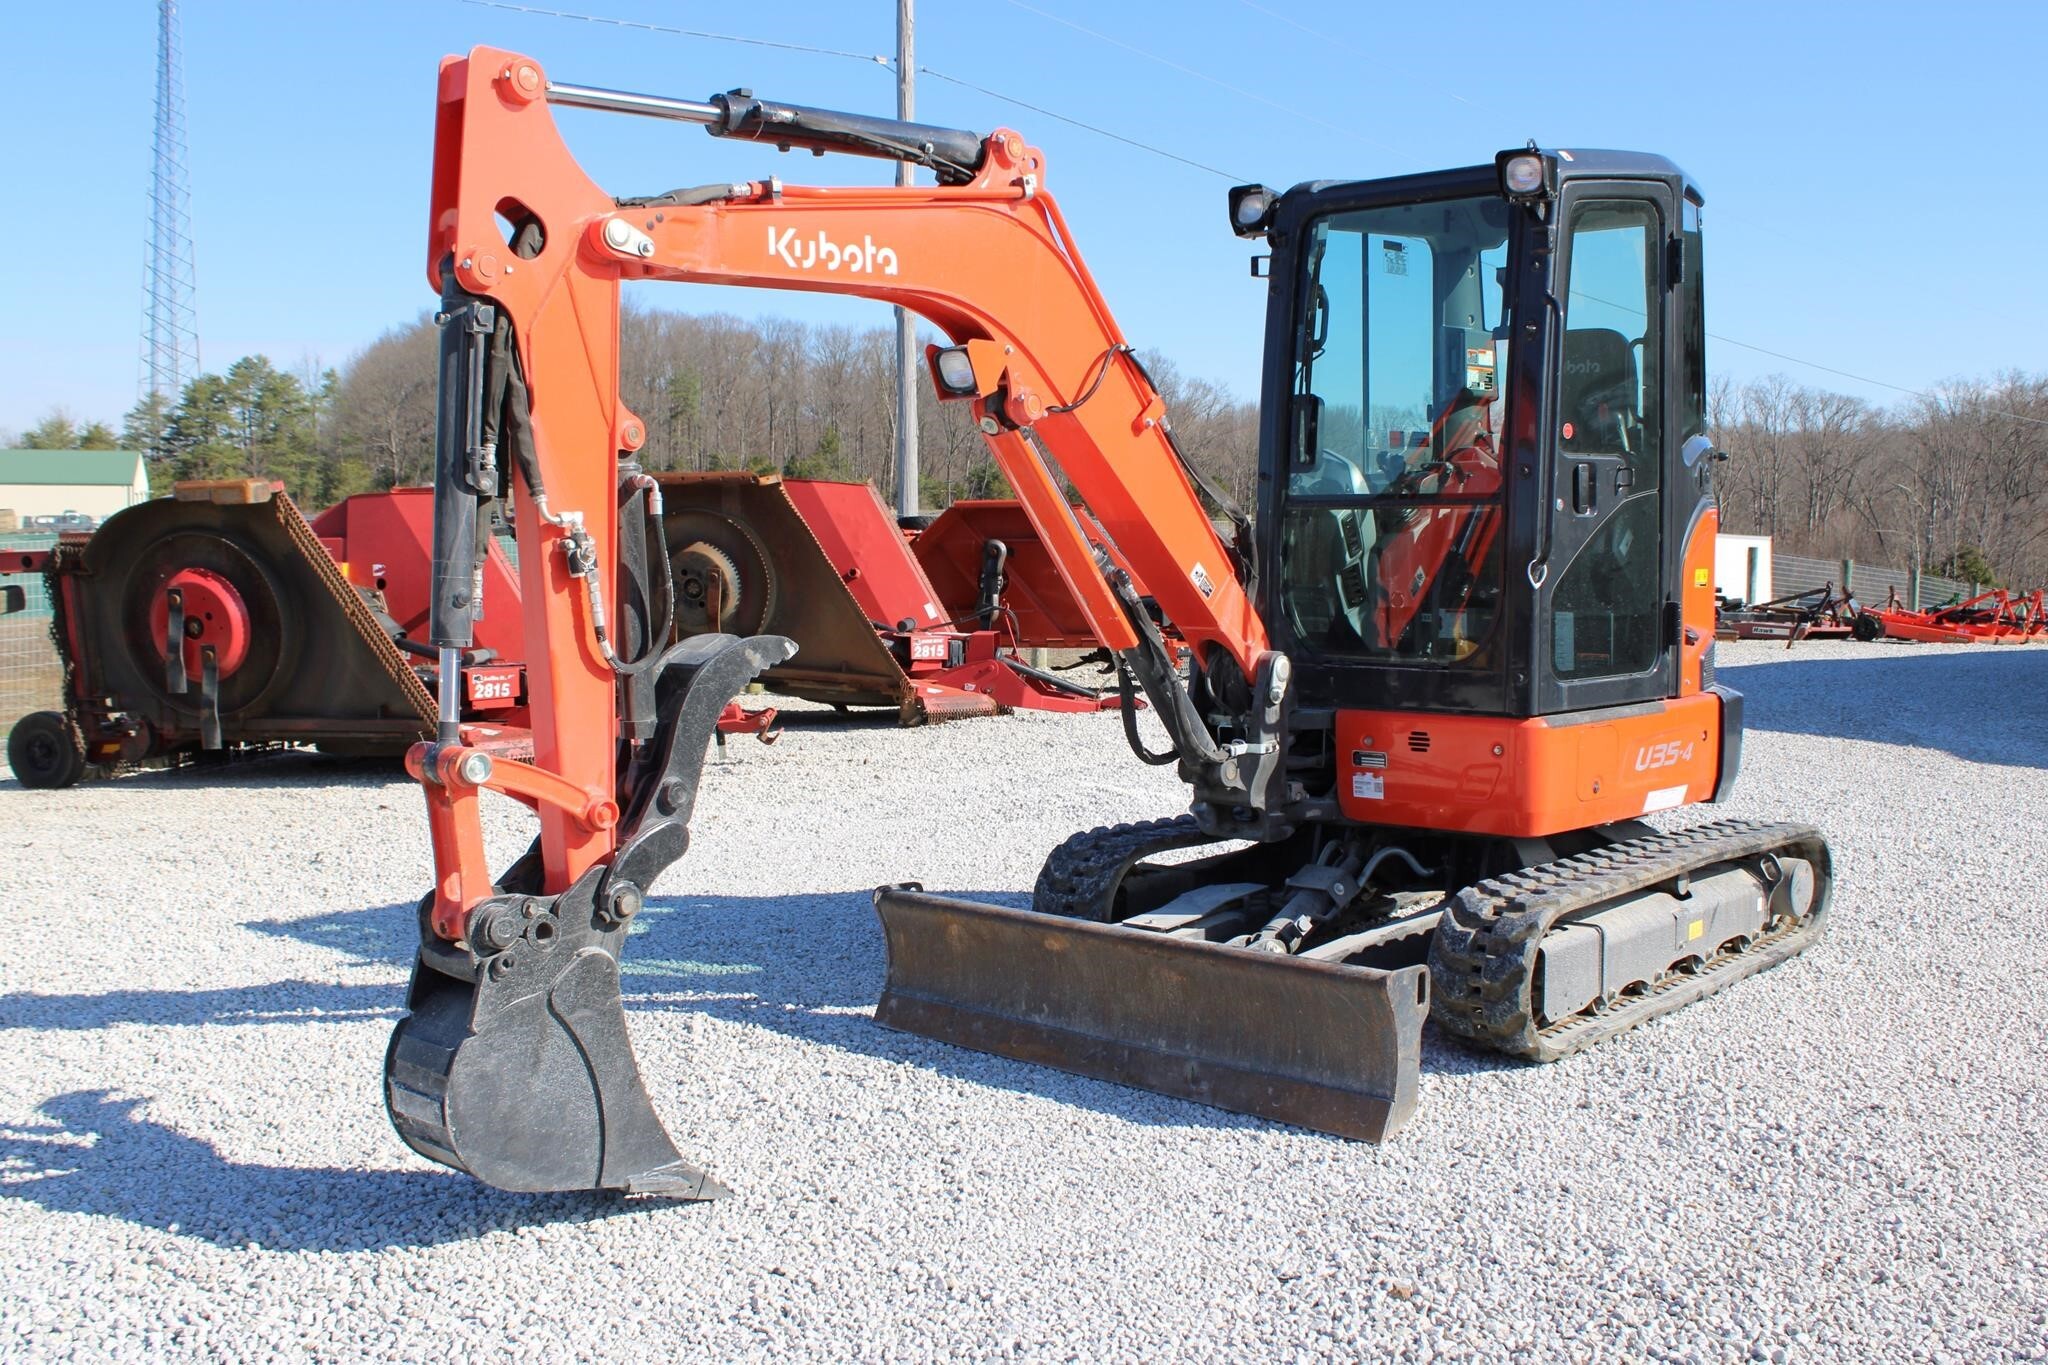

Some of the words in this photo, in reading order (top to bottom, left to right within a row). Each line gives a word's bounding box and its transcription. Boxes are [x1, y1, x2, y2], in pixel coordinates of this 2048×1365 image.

[768, 226, 898, 276] Kubota
[1566, 359, 1601, 374] bota
[914, 644, 945, 658] 2815
[474, 682, 511, 699] 2815
[1635, 740, 1695, 772] U35-4
